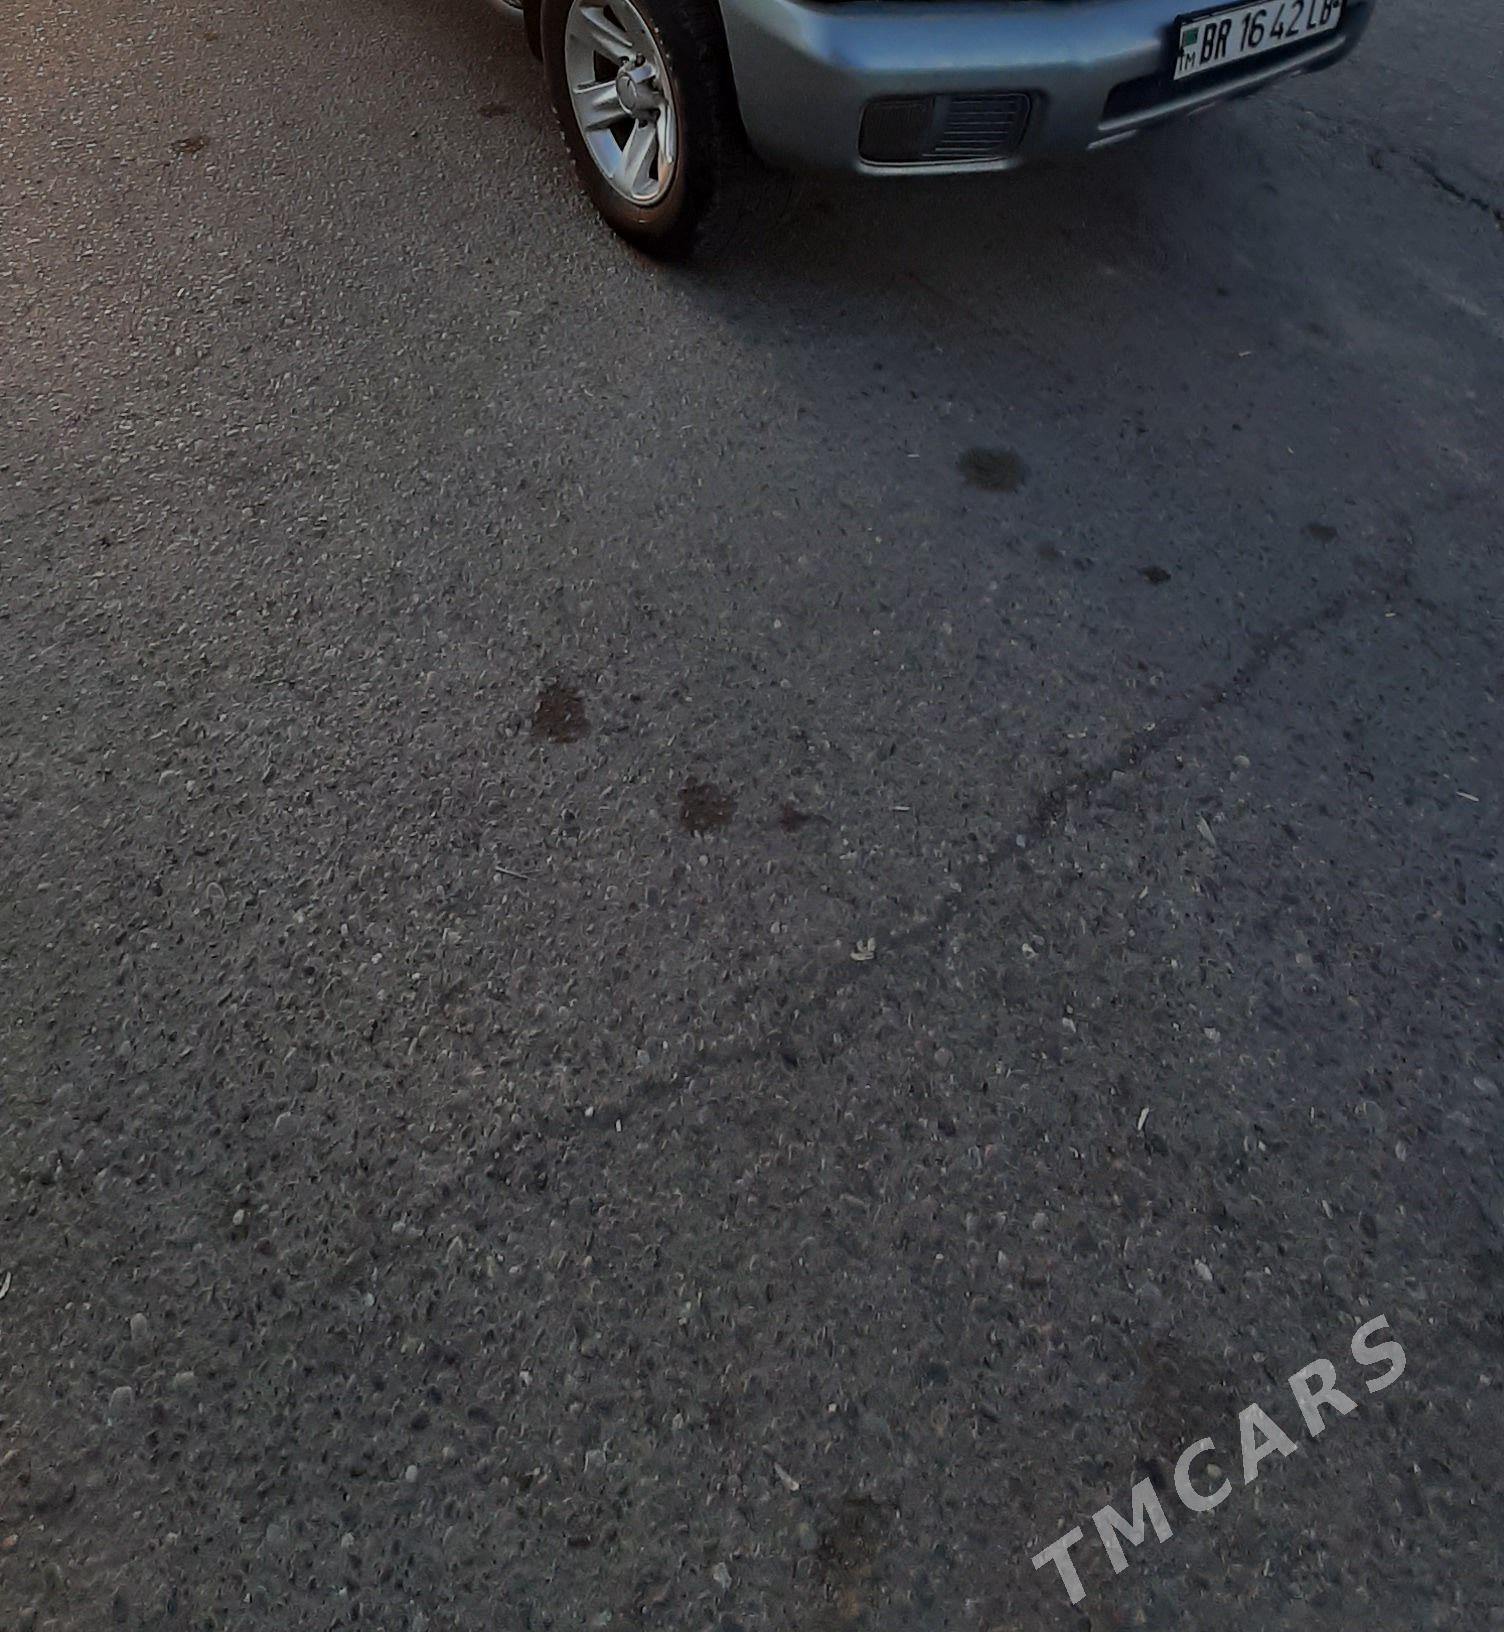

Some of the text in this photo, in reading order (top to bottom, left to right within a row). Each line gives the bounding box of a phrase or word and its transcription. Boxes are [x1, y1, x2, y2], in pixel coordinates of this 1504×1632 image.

[1201, 19, 1232, 63] BR
[1240, 11, 1265, 52] 16
[1270, 0, 1304, 40] 42
